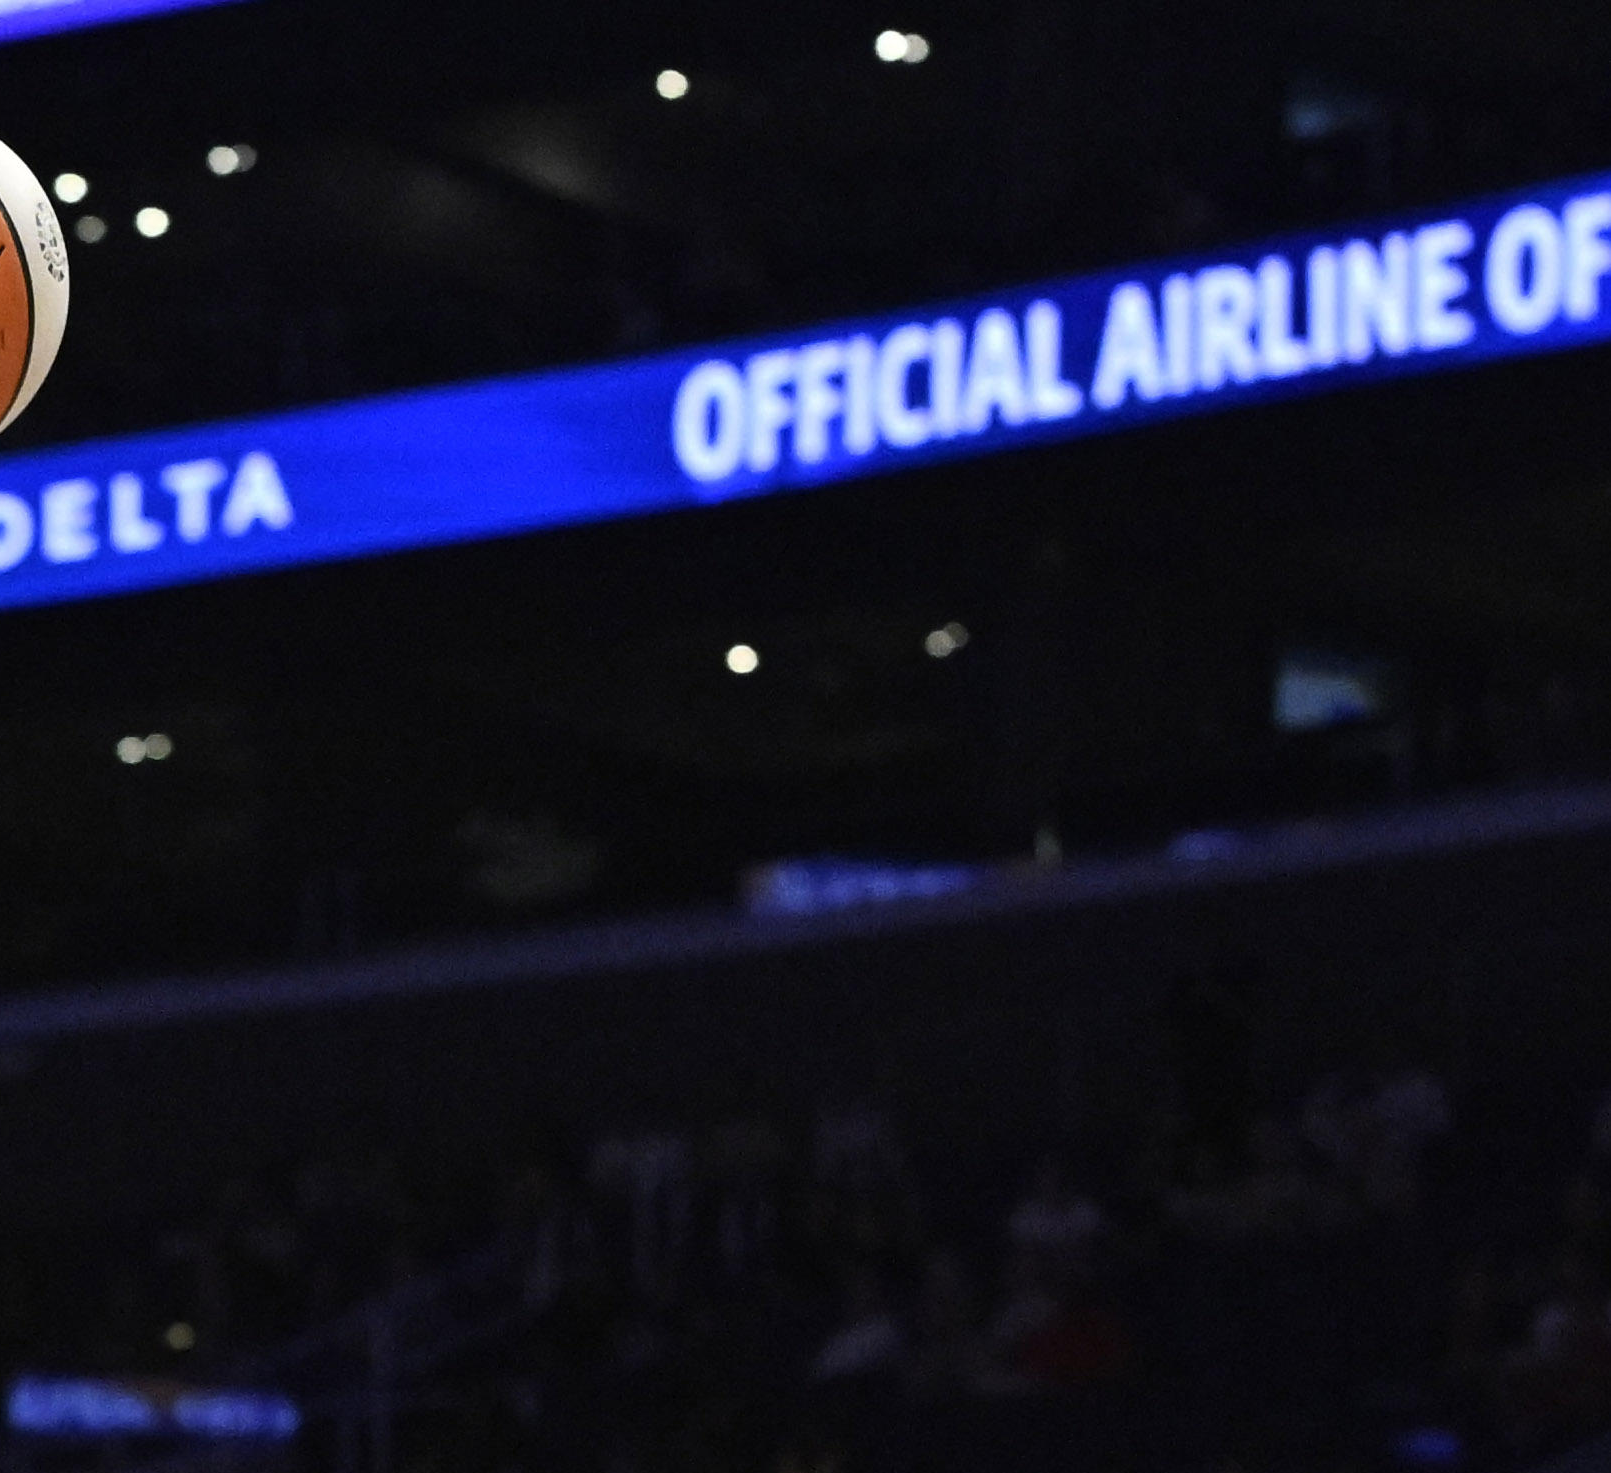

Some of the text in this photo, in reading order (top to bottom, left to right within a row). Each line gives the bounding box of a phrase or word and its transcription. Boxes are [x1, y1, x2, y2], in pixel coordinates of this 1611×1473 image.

[672, 192, 1611, 484] OFFICIAL AIRLINE OF
